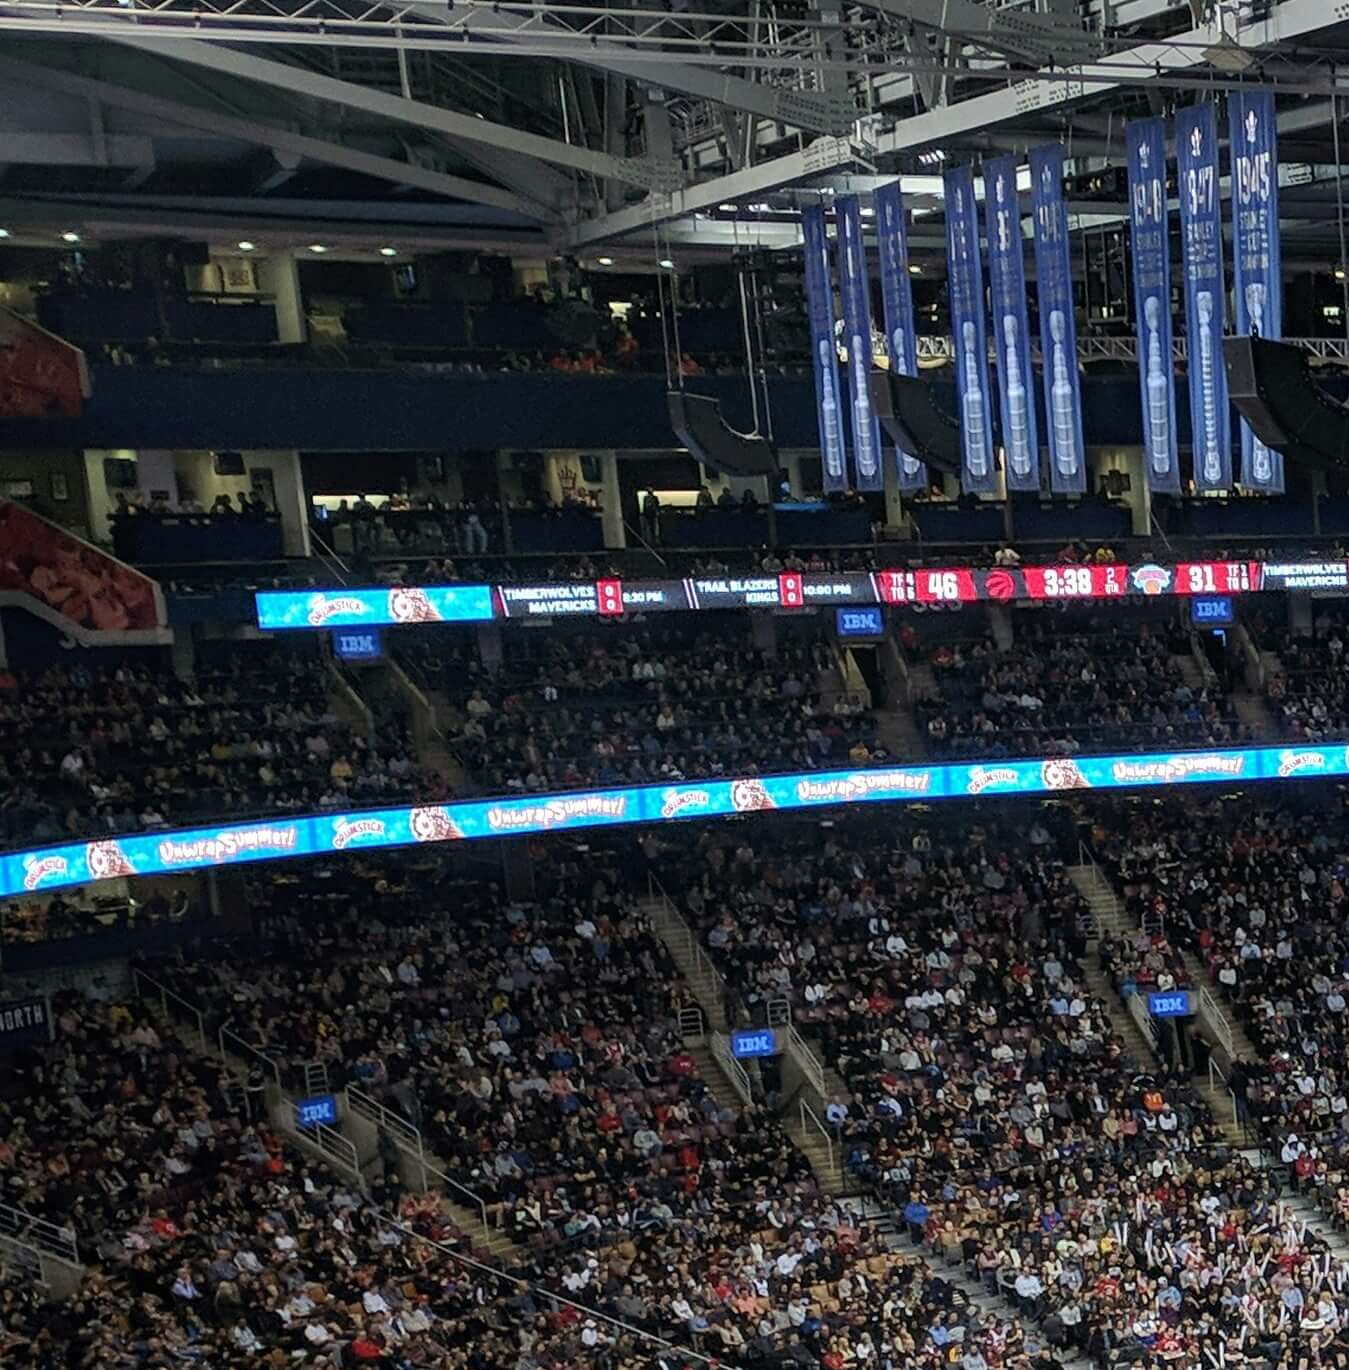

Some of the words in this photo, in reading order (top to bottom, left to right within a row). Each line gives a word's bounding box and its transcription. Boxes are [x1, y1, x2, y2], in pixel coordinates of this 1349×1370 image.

[1236, 152, 1270, 204] 1945
[1189, 565, 1216, 592] 31
[1263, 563, 1347, 577] TIMBERWOLVES
[698, 581, 729, 594] TRAIL
[730, 578, 778, 592] BLAZERS
[928, 572, 958, 598] 46
[1044, 568, 1093, 595] 3:38
[1285, 575, 1348, 588] MAVERICKS
[504, 585, 595, 601] TIMBERWOLVES
[746, 591, 779, 604] KINGS
[529, 599, 596, 613] MAVERICKS
[1196, 601, 1227, 617] IBM
[843, 613, 874, 631] IBM
[340, 635, 374, 651] IBM
[1154, 995, 1187, 1014] IBM
[738, 1036, 770, 1054] IBM
[302, 1102, 332, 1124] IBM
